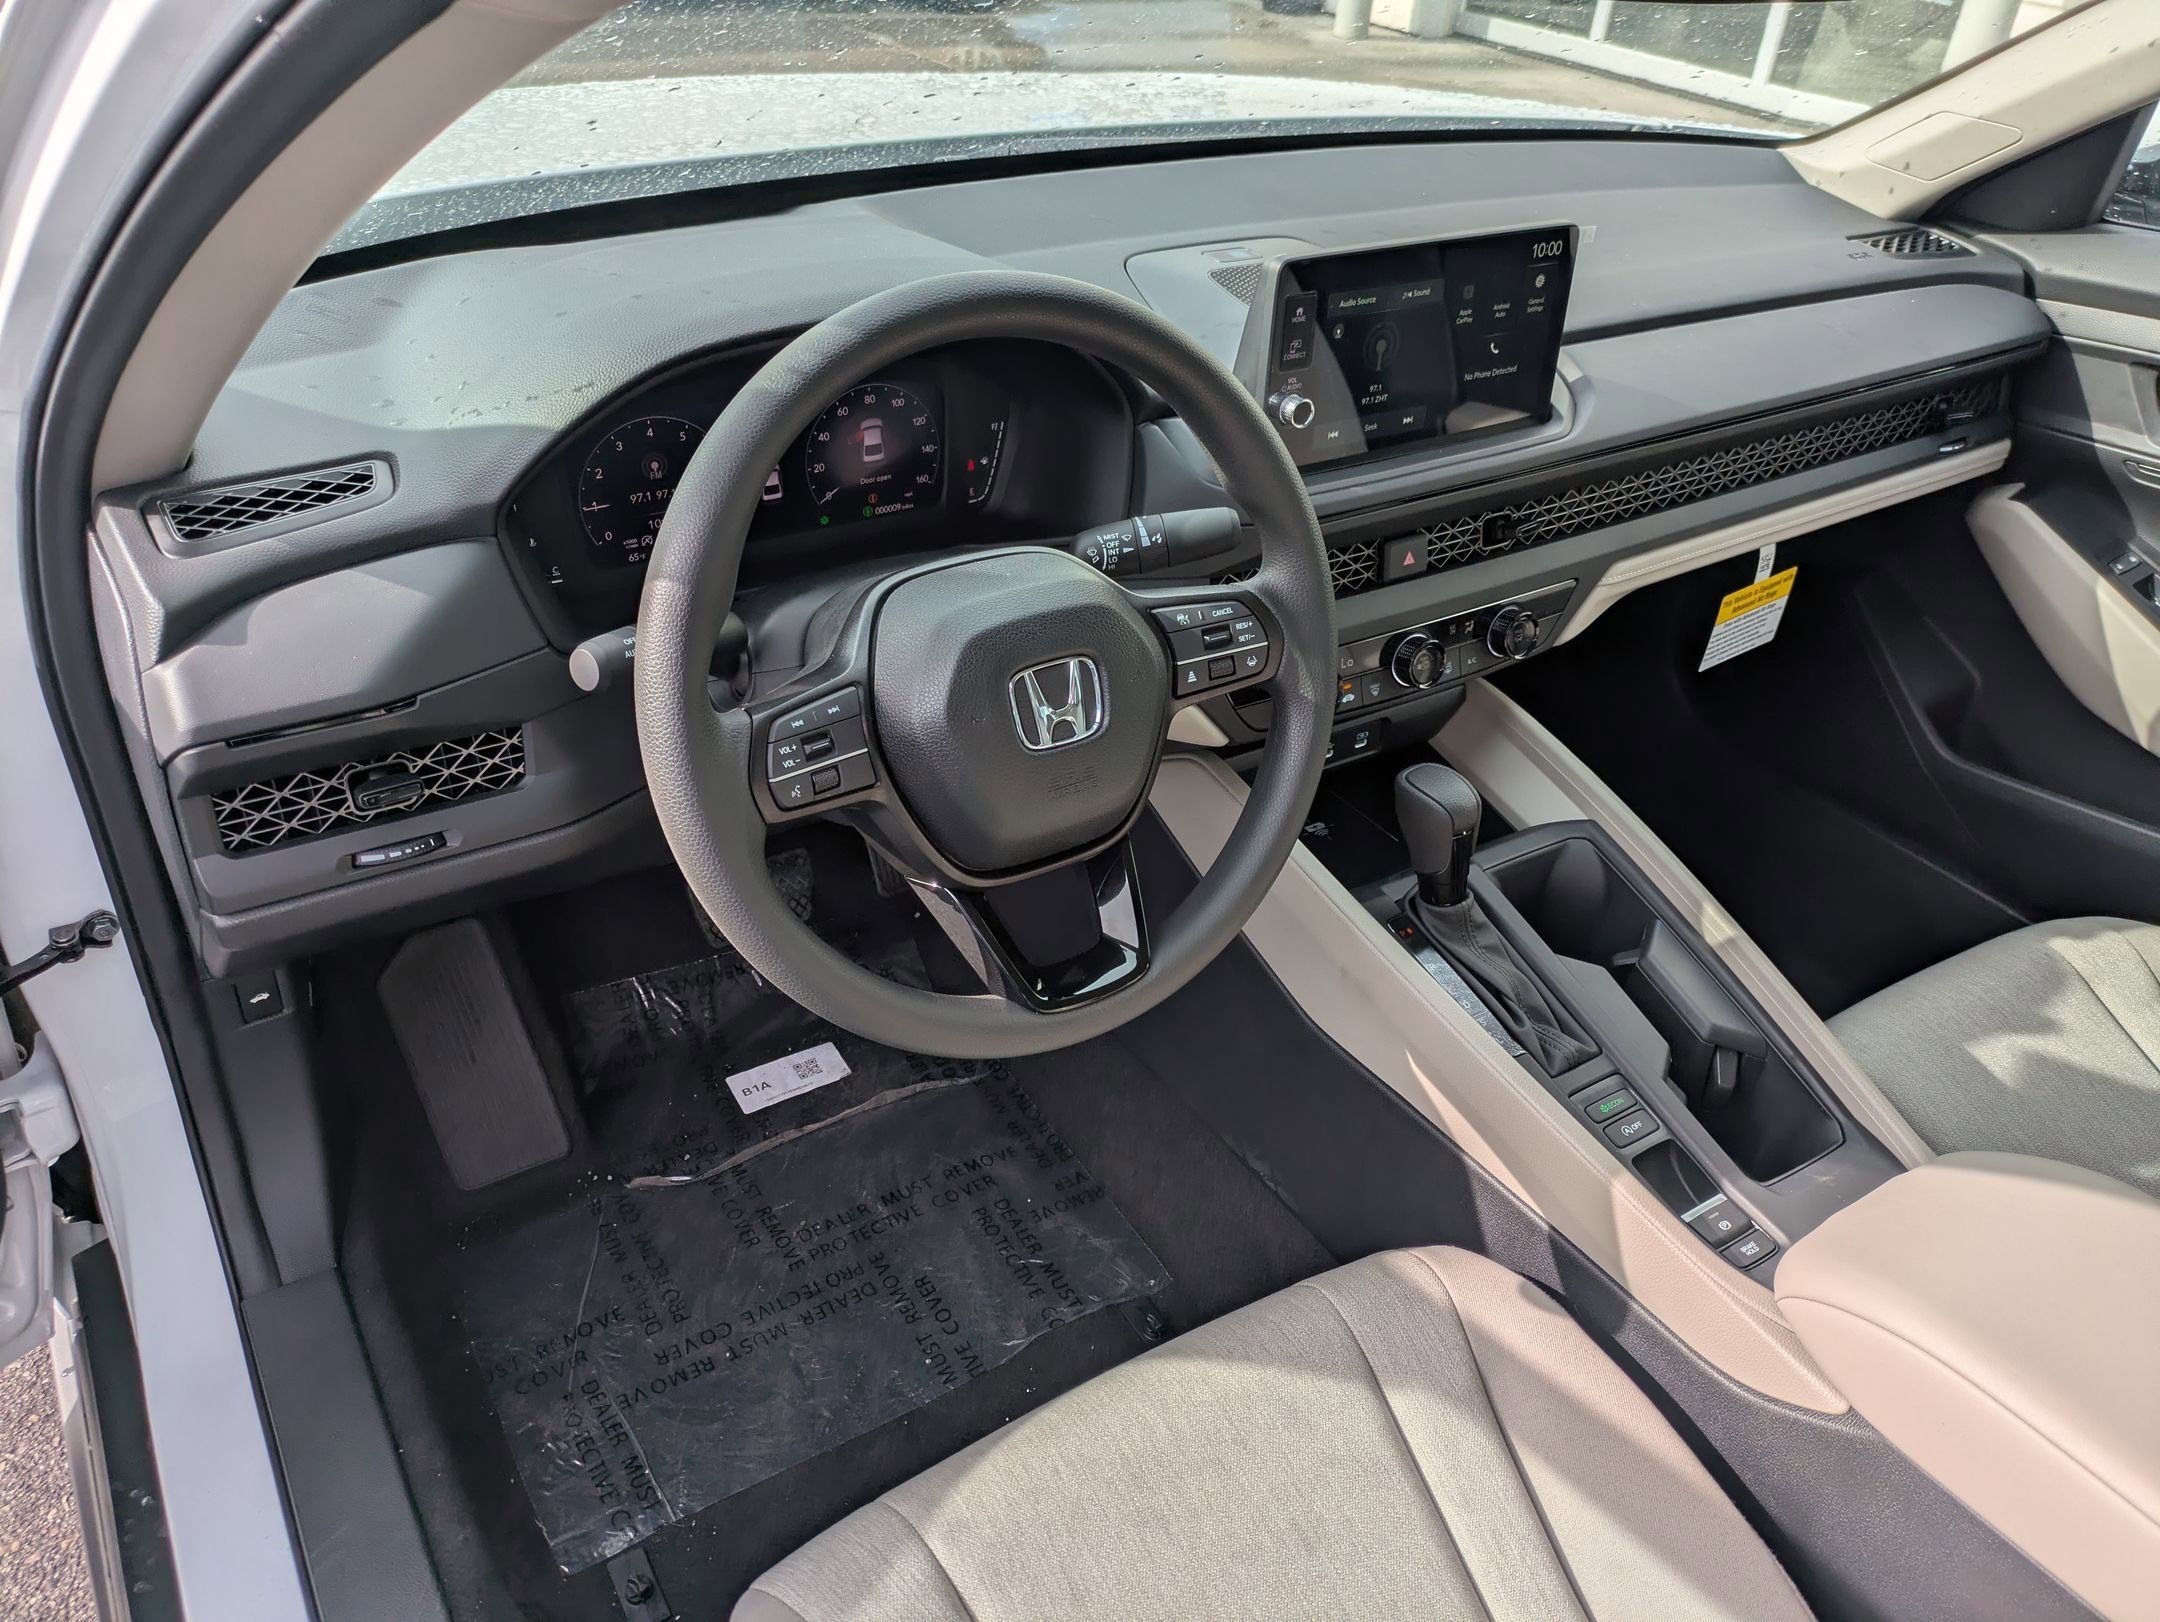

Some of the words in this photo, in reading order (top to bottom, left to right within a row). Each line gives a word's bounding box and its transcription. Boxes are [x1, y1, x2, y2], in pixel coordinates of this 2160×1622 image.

[1532, 240, 1564, 260] 10:00
[1413, 287, 1431, 297] Sound
[1339, 299, 1356, 309] Audio
[1357, 296, 1377, 305] Source
[1291, 315, 1307, 323] HOME
[1459, 309, 1473, 317] Apple
[1283, 351, 1307, 361] CONNECT
[1464, 373, 1473, 381] No
[1473, 370, 1492, 380] Phone
[1492, 365, 1518, 377] Detected
[1287, 383, 1303, 391] AUDIO
[1370, 384, 1383, 393] 97.1
[1361, 396, 1374, 406] 97.1
[1375, 394, 1389, 404] ZHT
[1364, 423, 1378, 432] Seek
[860, 477, 875, 485] Door
[876, 474, 892, 482] open
[916, 474, 929, 484] 160
[630, 491, 652, 504] 97.1
[875, 503, 901, 515] 000009
[1103, 532, 1119, 541] MIST
[1106, 541, 1120, 549] OFF
[1107, 548, 1120, 556] INT
[1108, 556, 1118, 564] LO
[1108, 563, 1116, 571] HI
[1212, 606, 1234, 617] CANCEL
[625, 649, 636, 658] AU
[742, 1081, 772, 1097] B1A
[1608, 1098, 1625, 1109] ECON
[1631, 1121, 1642, 1131] OFF
[799, 1203, 872, 1243] DEALER
[880, 1174, 934, 1207] MUST
[943, 1146, 1016, 1181] REMOVE
[1027, 1186, 1105, 1223] REMOVE
[731, 1165, 762, 1200] MUST
[755, 1205, 806, 1272] REMOVE
[808, 1202, 925, 1261] PROTECTIVE
[931, 1175, 999, 1208] COVER
[721, 1199, 760, 1250] COVER
[971, 1207, 1046, 1299] PROTECTIVE
[995, 1198, 1043, 1256] DEALER
[1040, 1261, 1083, 1308] MUST
[1744, 1246, 1759, 1256] HOLD
[868, 1251, 922, 1325] REMOVE
[741, 1263, 865, 1327] PROTECTIVE
[800, 1281, 878, 1327] DEALER
[914, 1274, 959, 1335] COVER
[653, 1321, 733, 1367] COVER
[728, 1322, 790, 1361] MUST
[915, 1334, 959, 1386] MUST
[616, 1356, 716, 1410] REMOVE
[581, 1379, 630, 1448] DEALER
[621, 1454, 660, 1511] MUST
